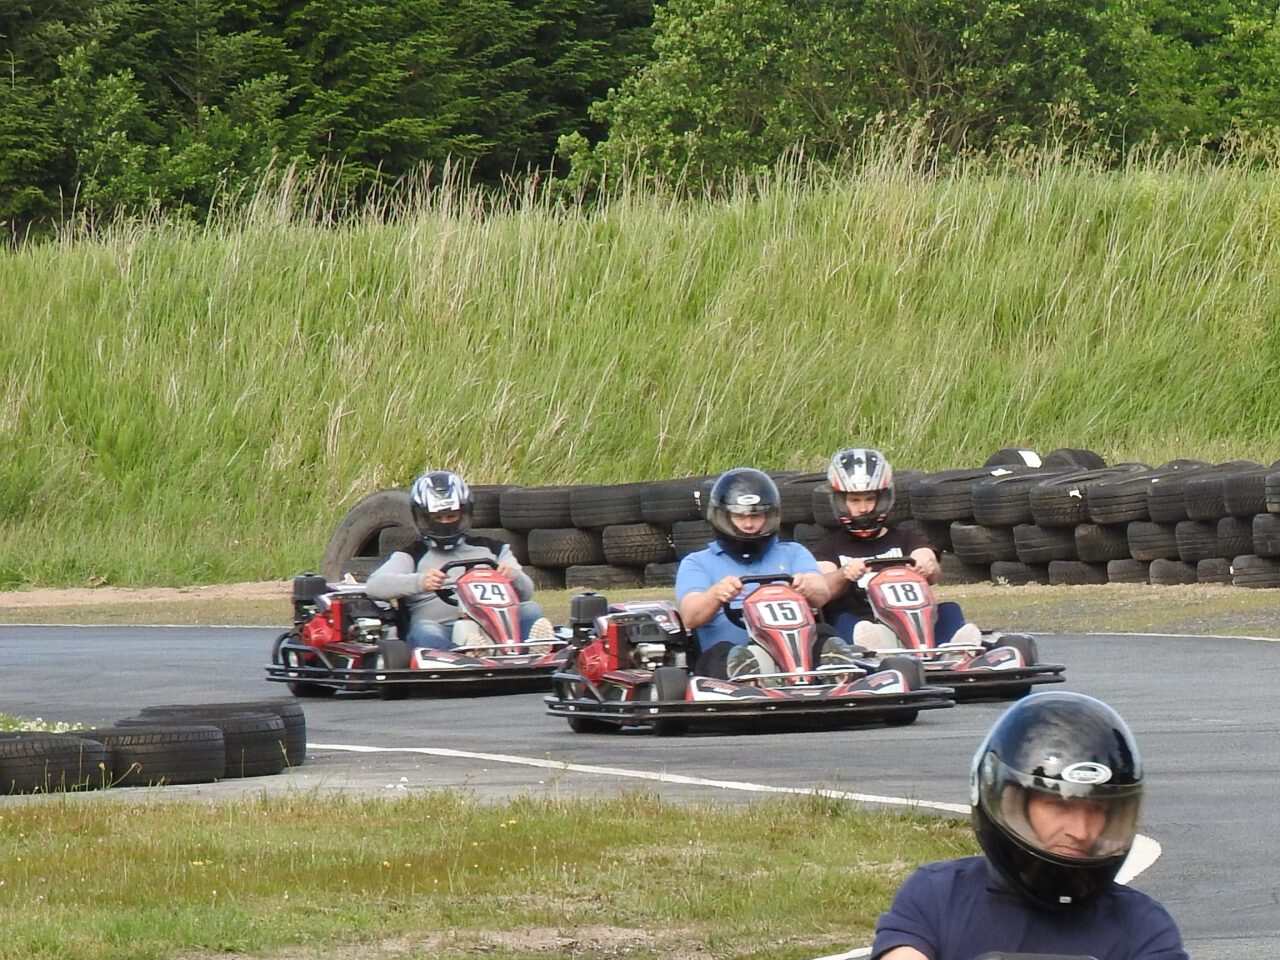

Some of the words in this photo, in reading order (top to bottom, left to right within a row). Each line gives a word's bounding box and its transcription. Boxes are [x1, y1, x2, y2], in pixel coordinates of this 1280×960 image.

[473, 584, 506, 601] 24
[887, 583, 919, 603] 18
[764, 602, 798, 622] 15
